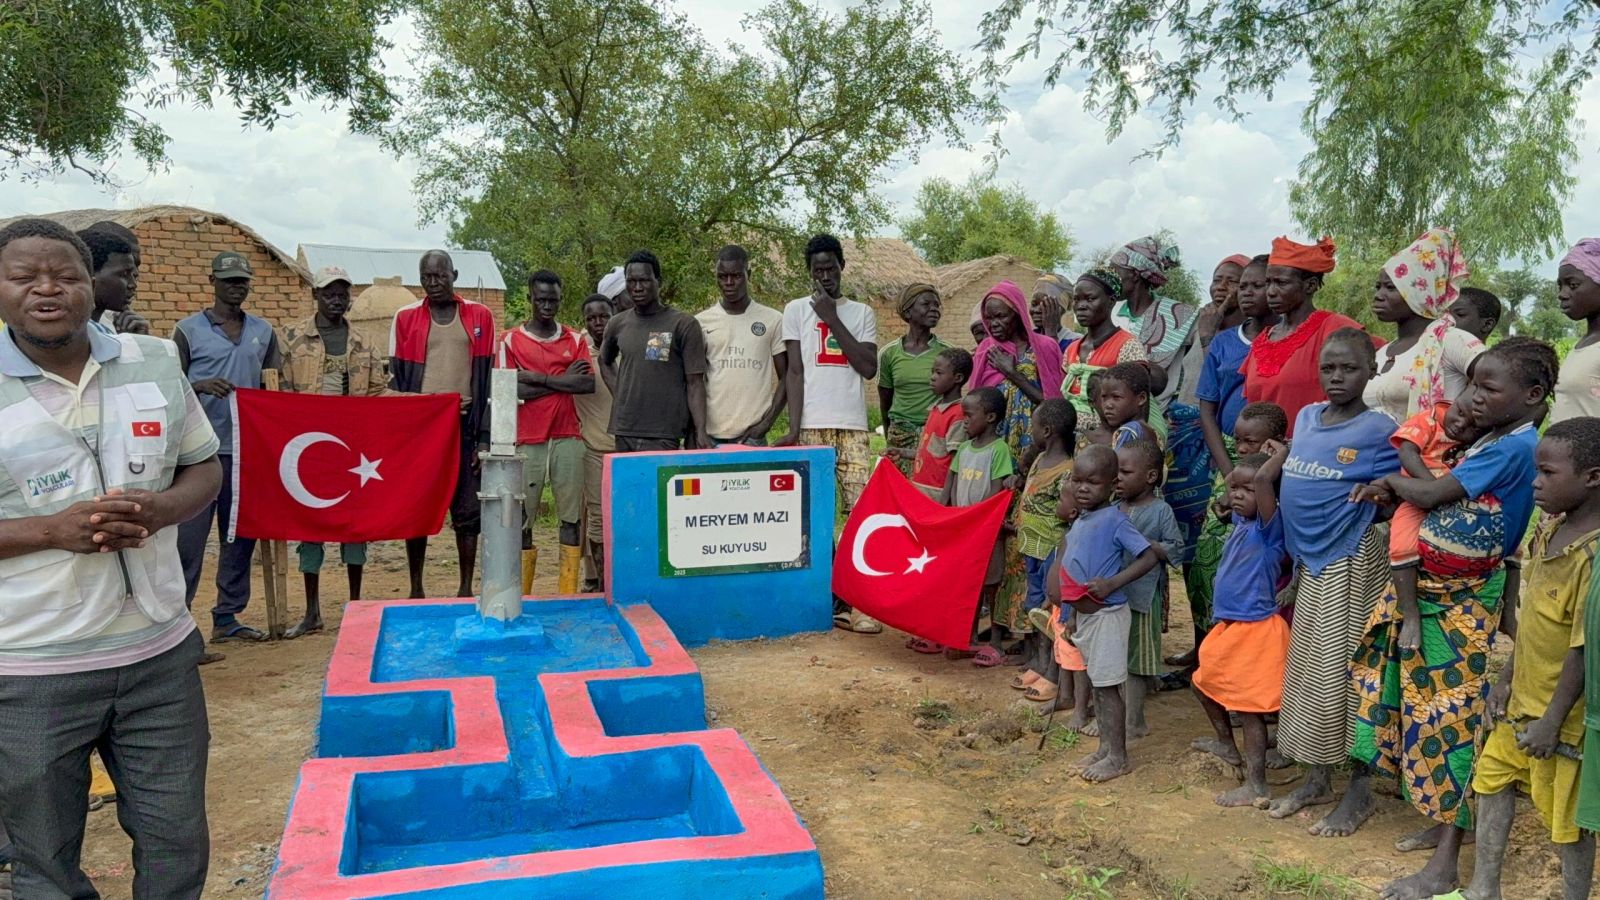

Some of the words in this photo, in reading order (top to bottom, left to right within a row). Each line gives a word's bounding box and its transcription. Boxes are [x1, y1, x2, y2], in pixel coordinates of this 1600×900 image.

[728, 346, 745, 356] Fly
[685, 513, 748, 528] MERYEM
[753, 511, 789, 523] MAZI
[702, 545, 717, 555] SU
[719, 541, 767, 554] KUYUSU
